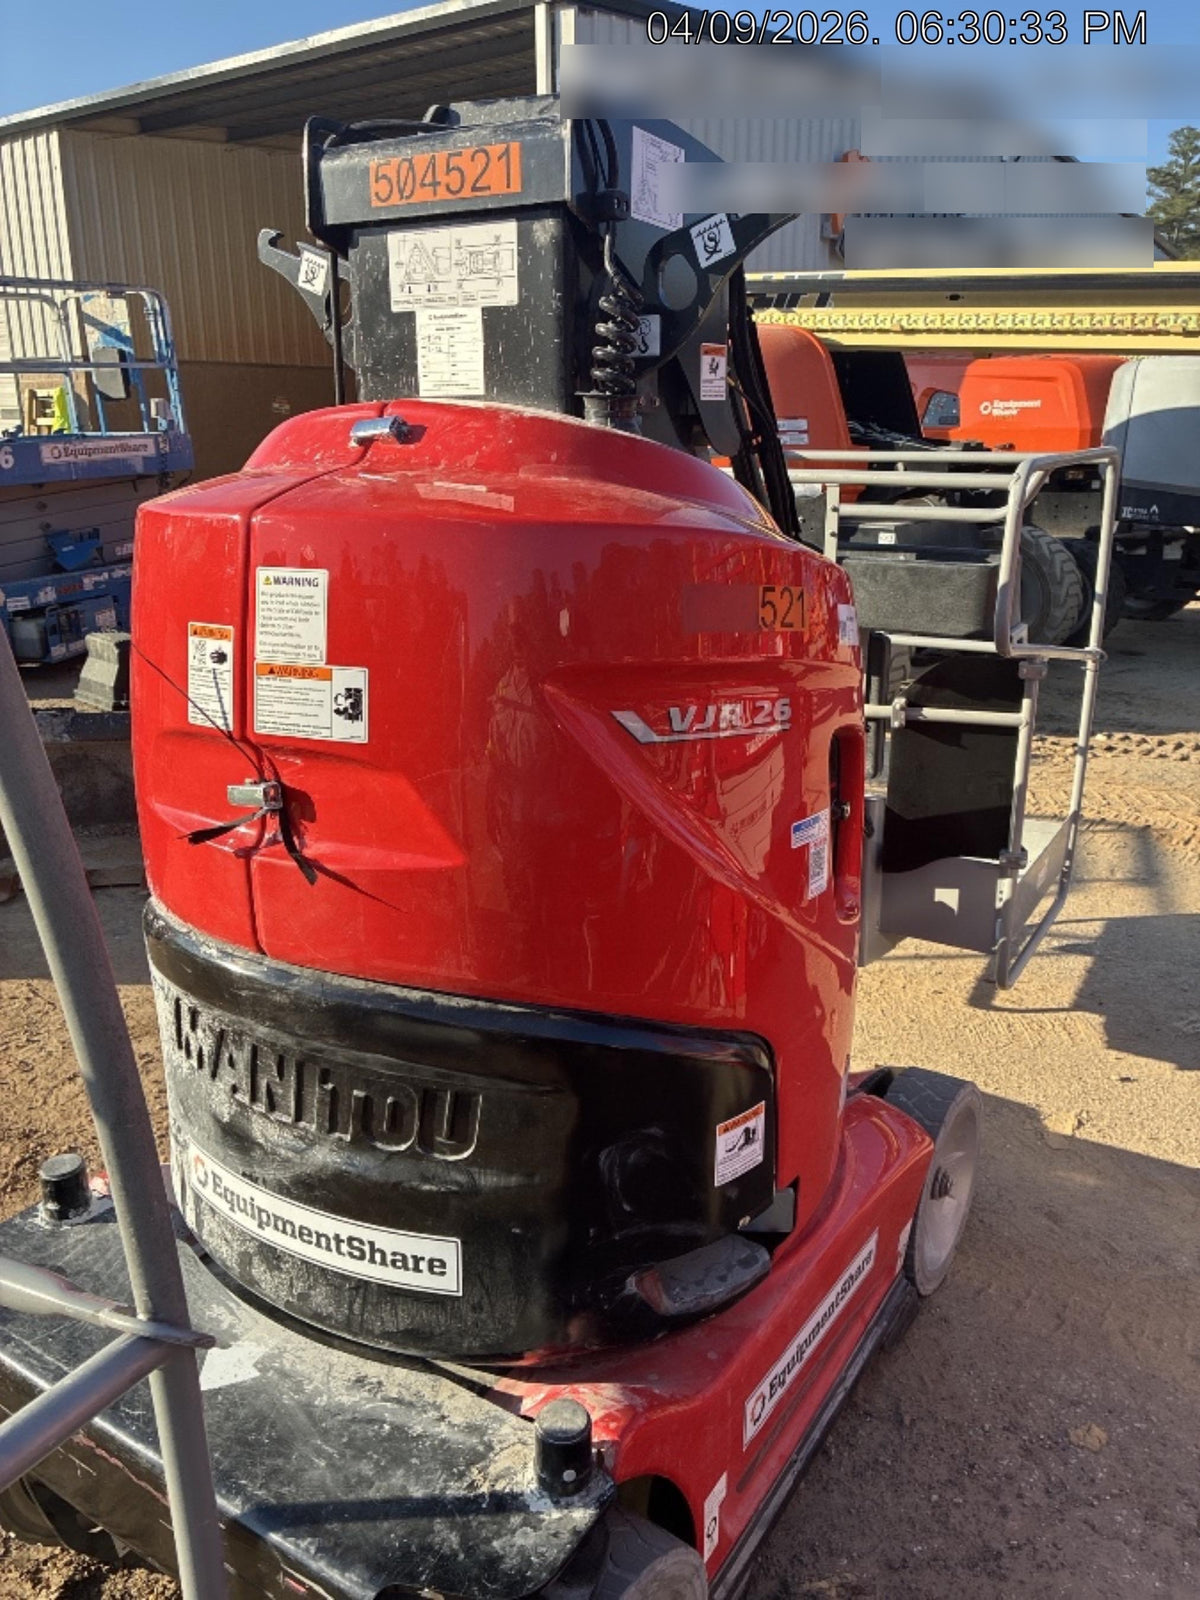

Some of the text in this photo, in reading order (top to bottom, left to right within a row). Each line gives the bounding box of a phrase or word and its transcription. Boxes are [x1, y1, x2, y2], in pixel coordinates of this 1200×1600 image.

[374, 144, 512, 203] 504521
[0, 446, 15, 469] 6
[272, 575, 319, 588] WARNING
[669, 698, 792, 733] VJR 26
[210, 1172, 448, 1278] EquipmentShare
[767, 1250, 874, 1401] EquipmentShare
